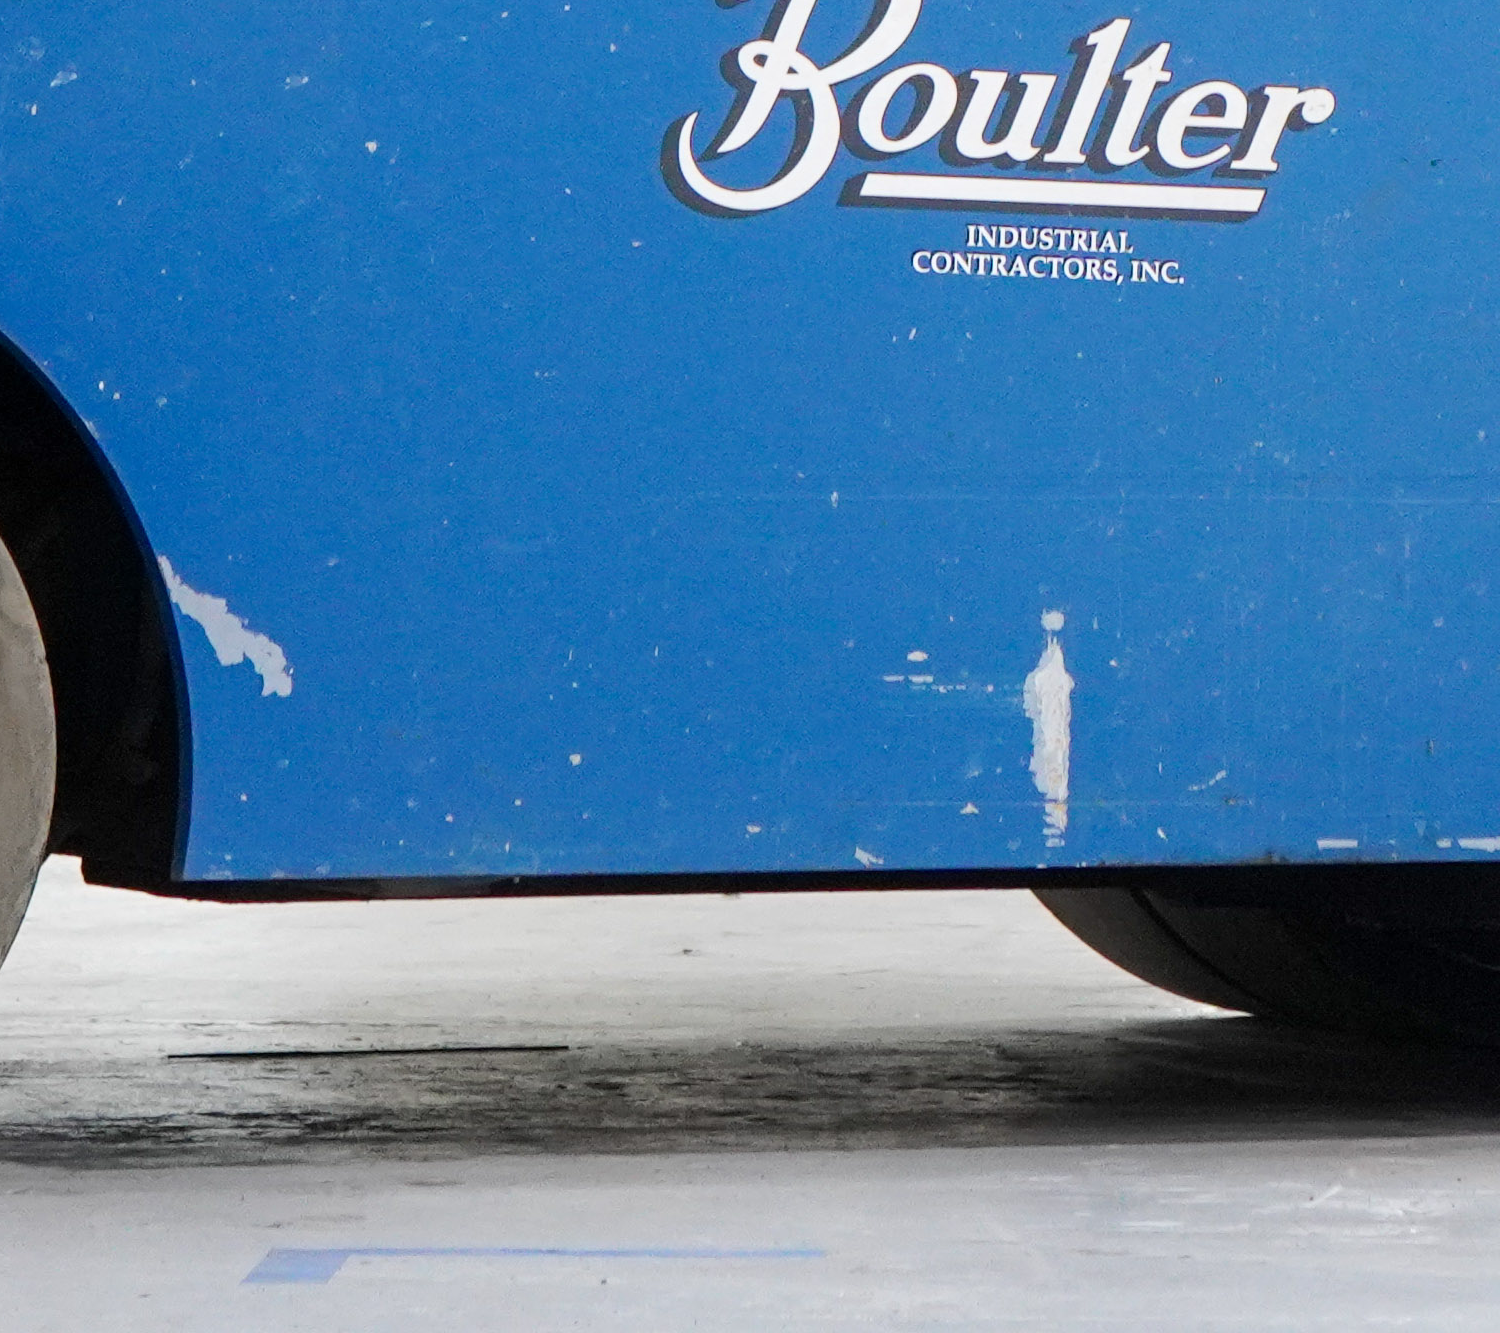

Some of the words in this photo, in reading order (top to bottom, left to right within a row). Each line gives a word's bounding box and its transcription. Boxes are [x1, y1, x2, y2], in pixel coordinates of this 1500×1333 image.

[965, 223, 1134, 254] INDUSTRIAL
[911, 250, 1124, 285] CONTRACTORS,
[1129, 259, 1186, 284] INC.
